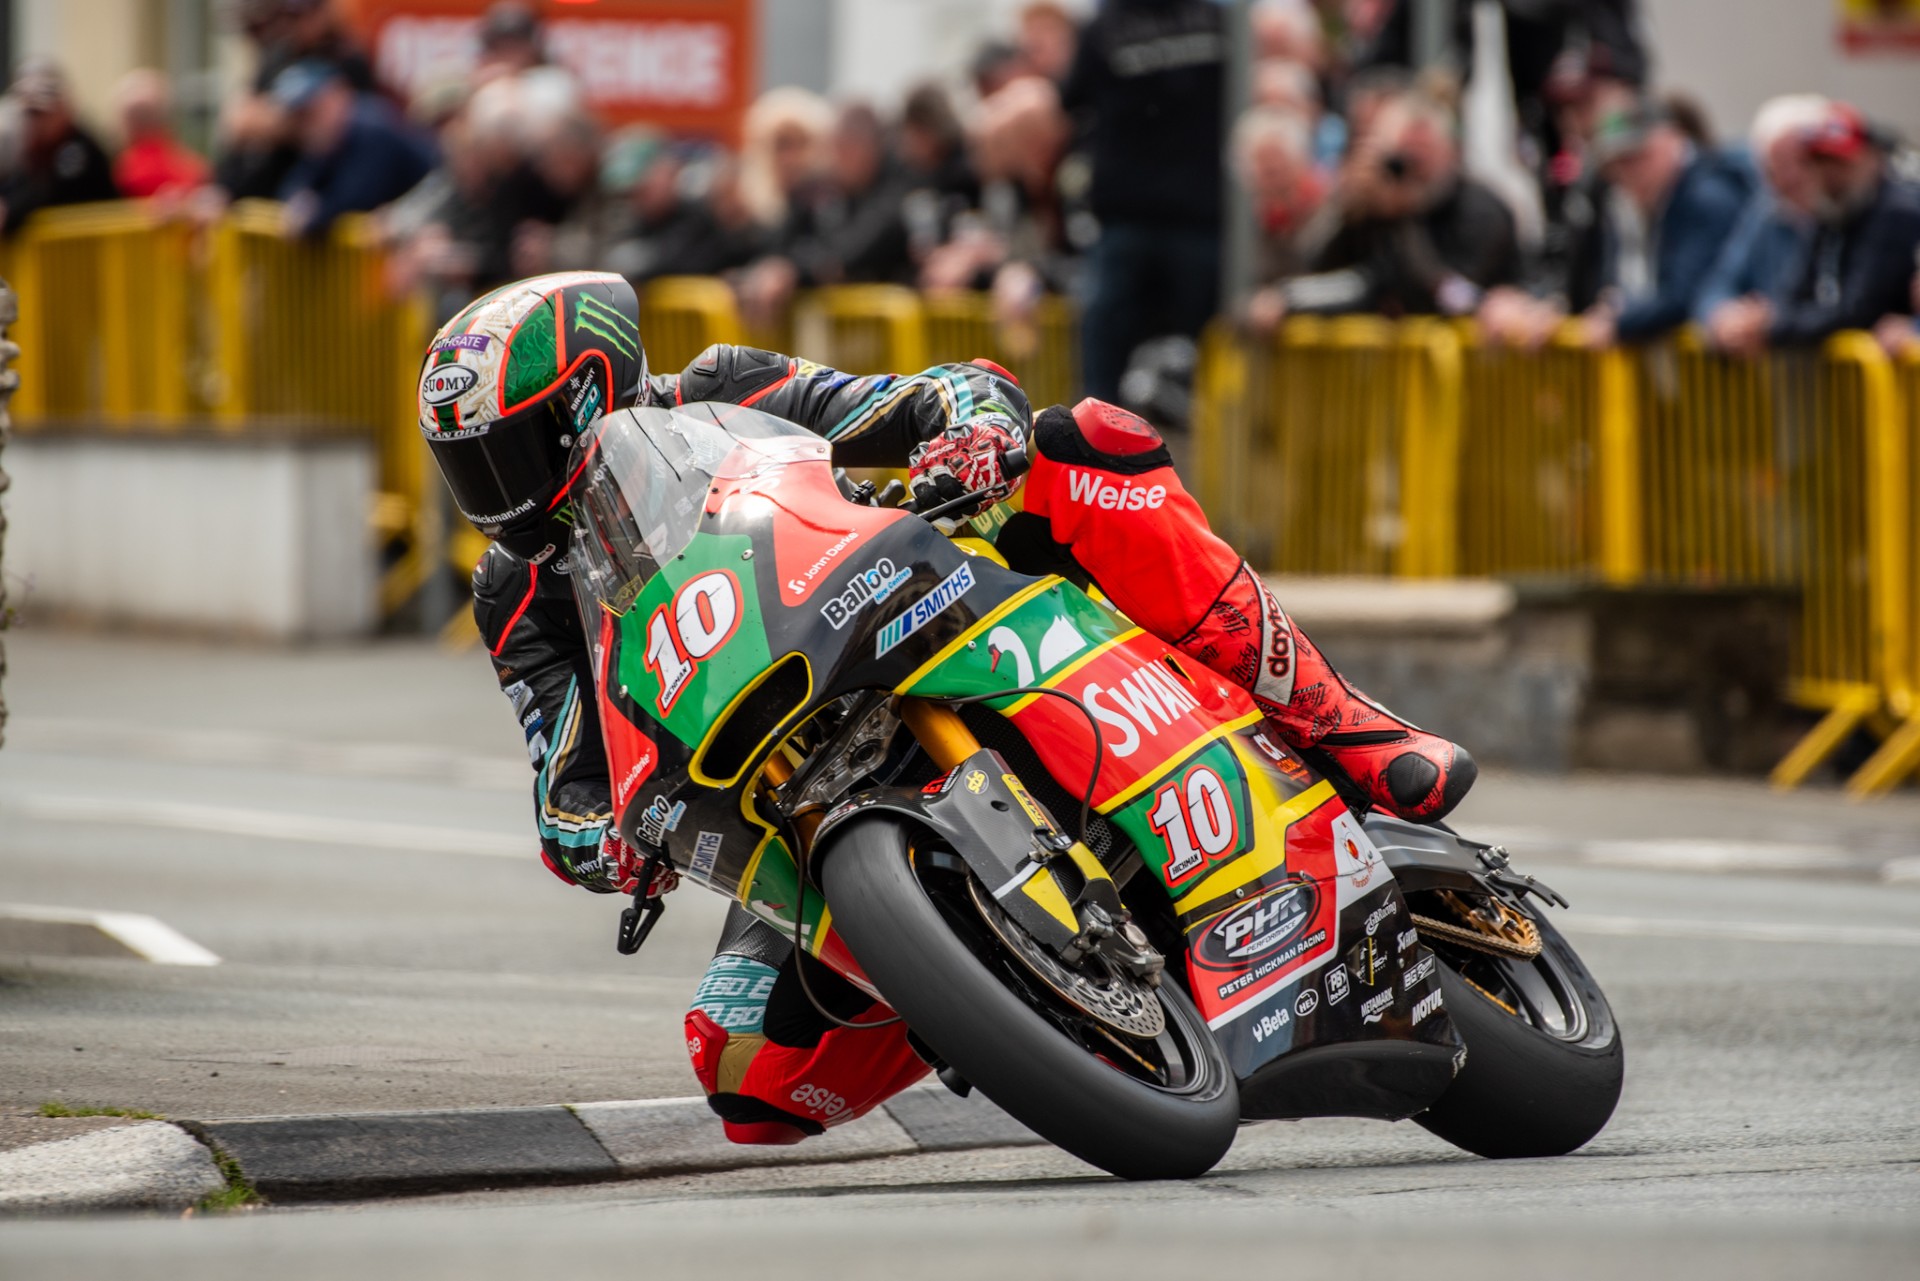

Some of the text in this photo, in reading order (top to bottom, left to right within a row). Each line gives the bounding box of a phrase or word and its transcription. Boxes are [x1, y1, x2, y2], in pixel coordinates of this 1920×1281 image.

[423, 376, 471, 391] SUOMY
[570, 367, 596, 411] BREMONT
[1068, 469, 1167, 511] Weise
[804, 532, 859, 580] John Darke
[822, 558, 895, 629] Balloo
[915, 567, 971, 625] SMITHS
[645, 570, 740, 714] 10
[1083, 659, 1201, 758] SWAN
[637, 795, 672, 847] Balloo
[1149, 766, 1236, 884] 10
[694, 834, 720, 869] SMITHS
[1246, 919, 1297, 954] PERFORMANCE
[1219, 930, 1326, 998] PETER HICKMAN RACING
[1260, 1007, 1290, 1035] Beta
[1299, 999, 1314, 1014] HEL
[1361, 987, 1394, 1017] METAMARK
[1412, 988, 1443, 1026] MOTUL
